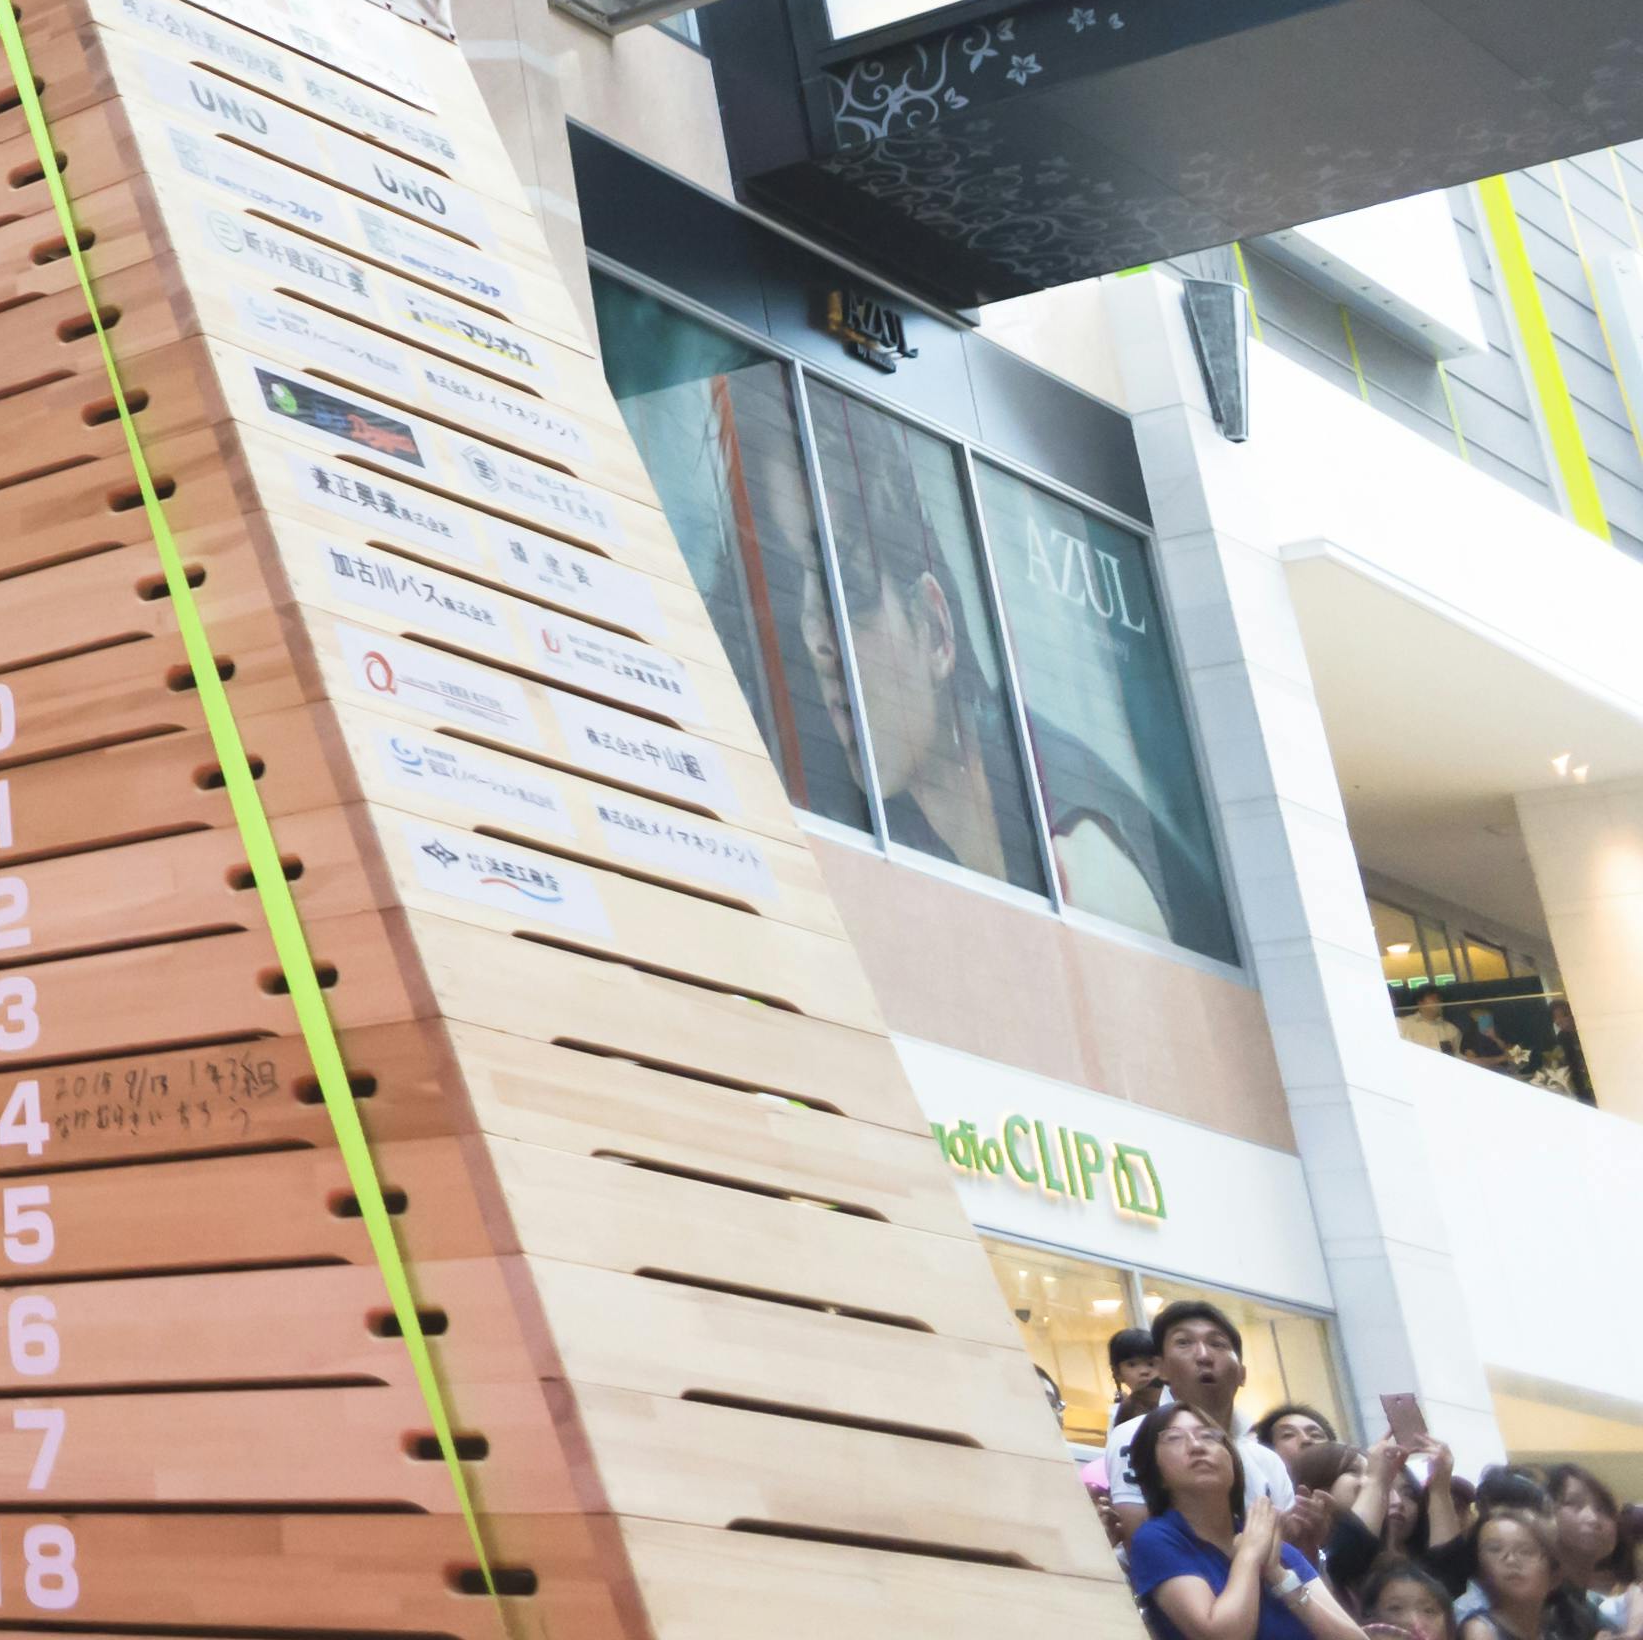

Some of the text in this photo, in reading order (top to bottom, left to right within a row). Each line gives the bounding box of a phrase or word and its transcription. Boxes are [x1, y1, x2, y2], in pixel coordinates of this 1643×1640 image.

[189, 78, 268, 135] UNO
[373, 161, 447, 216] UNO
[1026, 515, 1146, 635] AZUL
